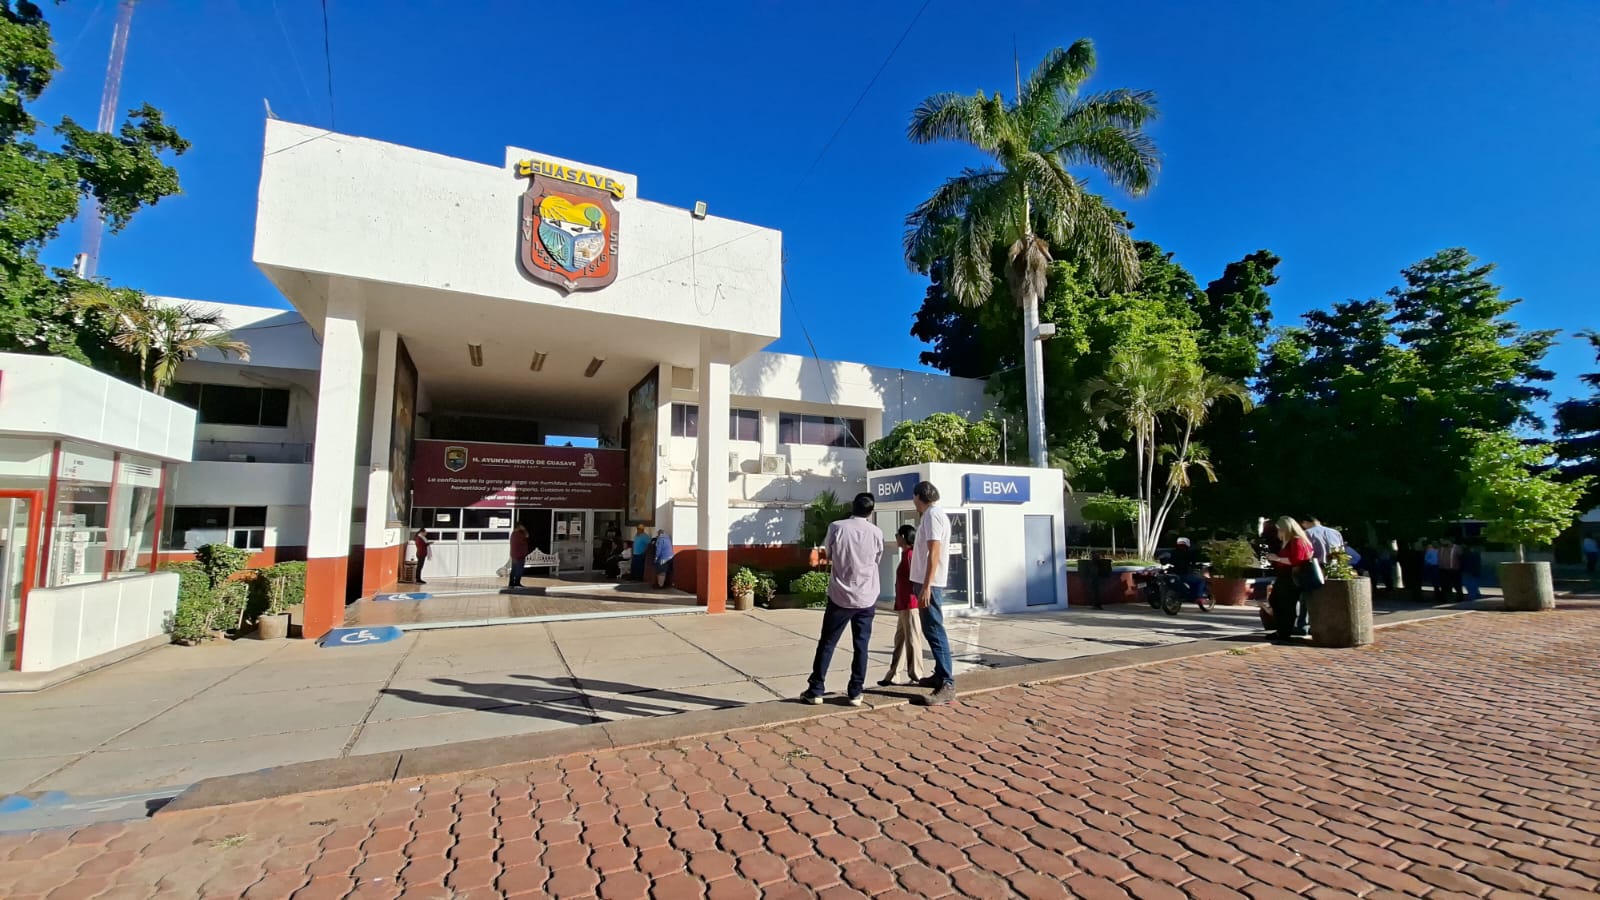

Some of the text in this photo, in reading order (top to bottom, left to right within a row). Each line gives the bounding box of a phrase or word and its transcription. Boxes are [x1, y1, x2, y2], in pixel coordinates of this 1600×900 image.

[530, 160, 615, 190] GUASAVE
[481, 457, 535, 465] AYUNTAMIENTO
[878, 480, 904, 496] BBVA
[984, 481, 1018, 495] BBVA
